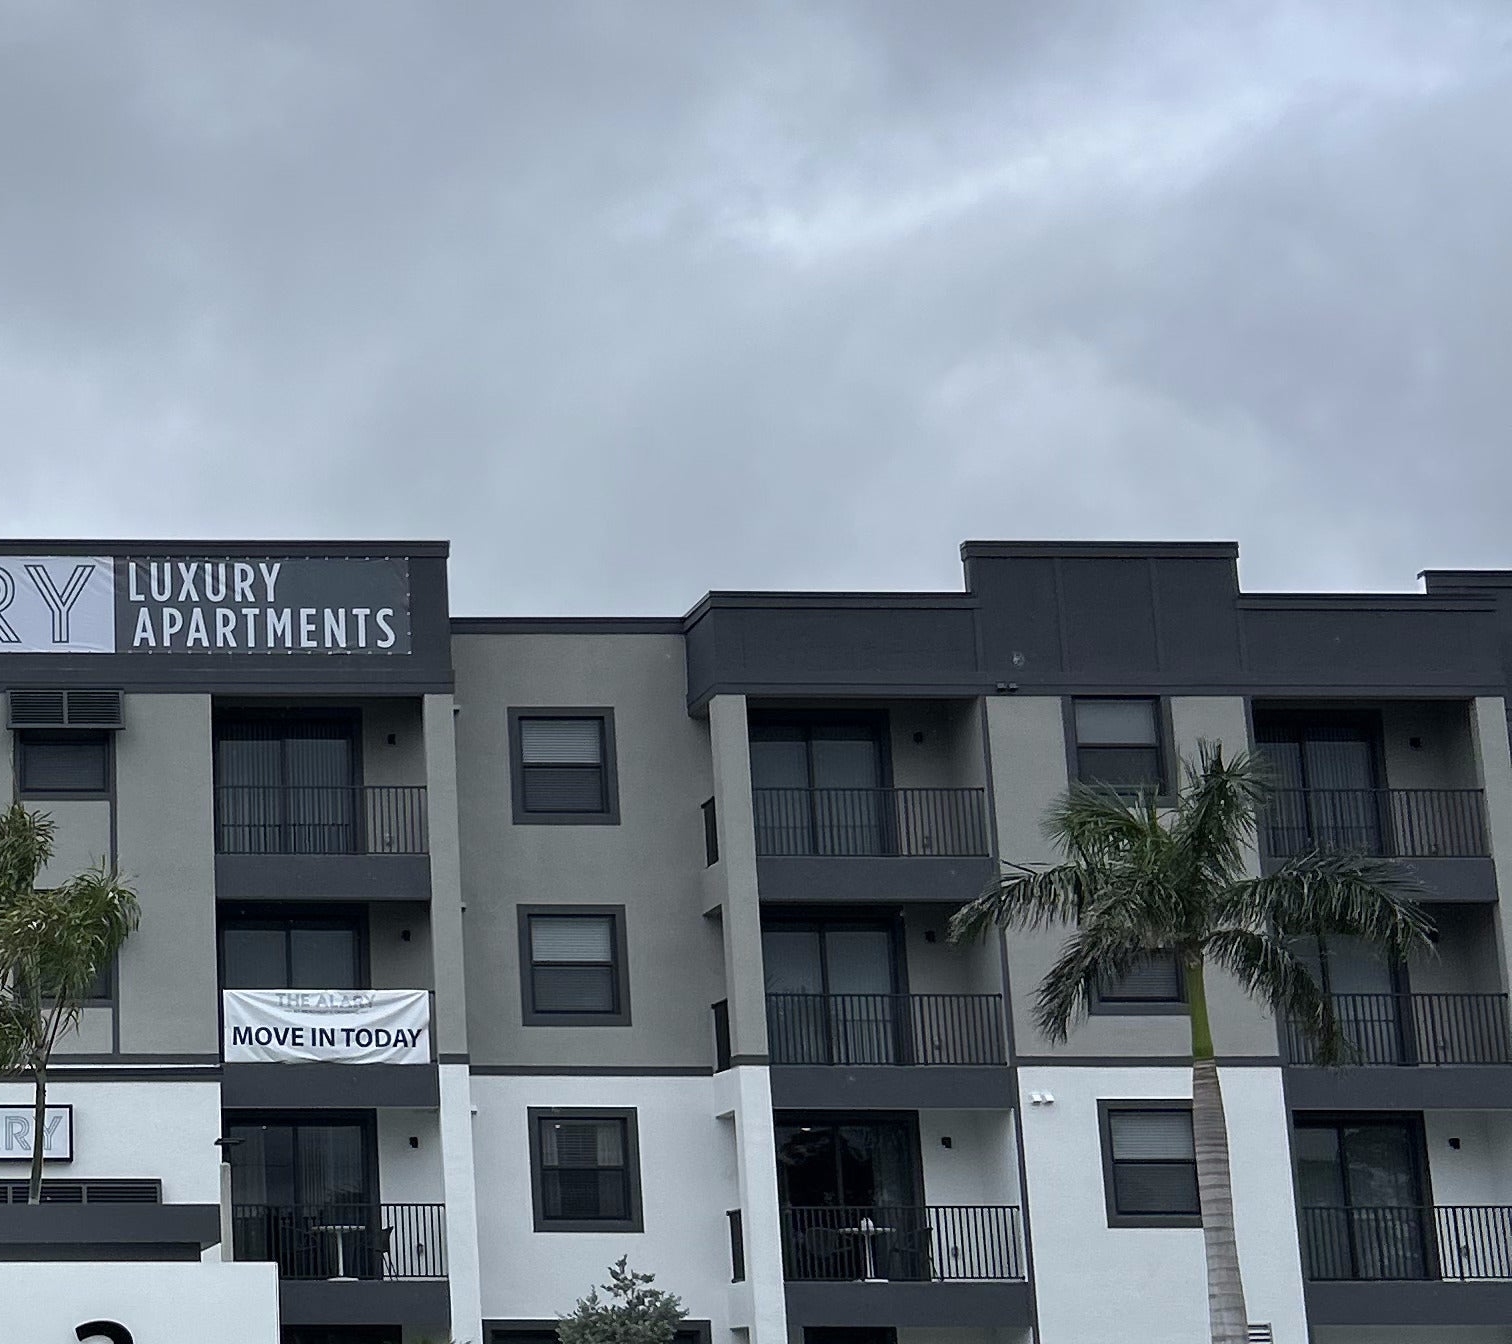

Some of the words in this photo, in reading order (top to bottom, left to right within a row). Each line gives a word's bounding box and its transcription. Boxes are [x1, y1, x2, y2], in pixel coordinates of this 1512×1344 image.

[128, 562, 282, 603] LUXURY
[132, 607, 397, 649] APARTMENTS
[275, 992, 310, 1008] THE
[232, 1026, 305, 1047] MOVE
[311, 1027, 336, 1047] IN
[340, 1027, 423, 1049] TODAY
